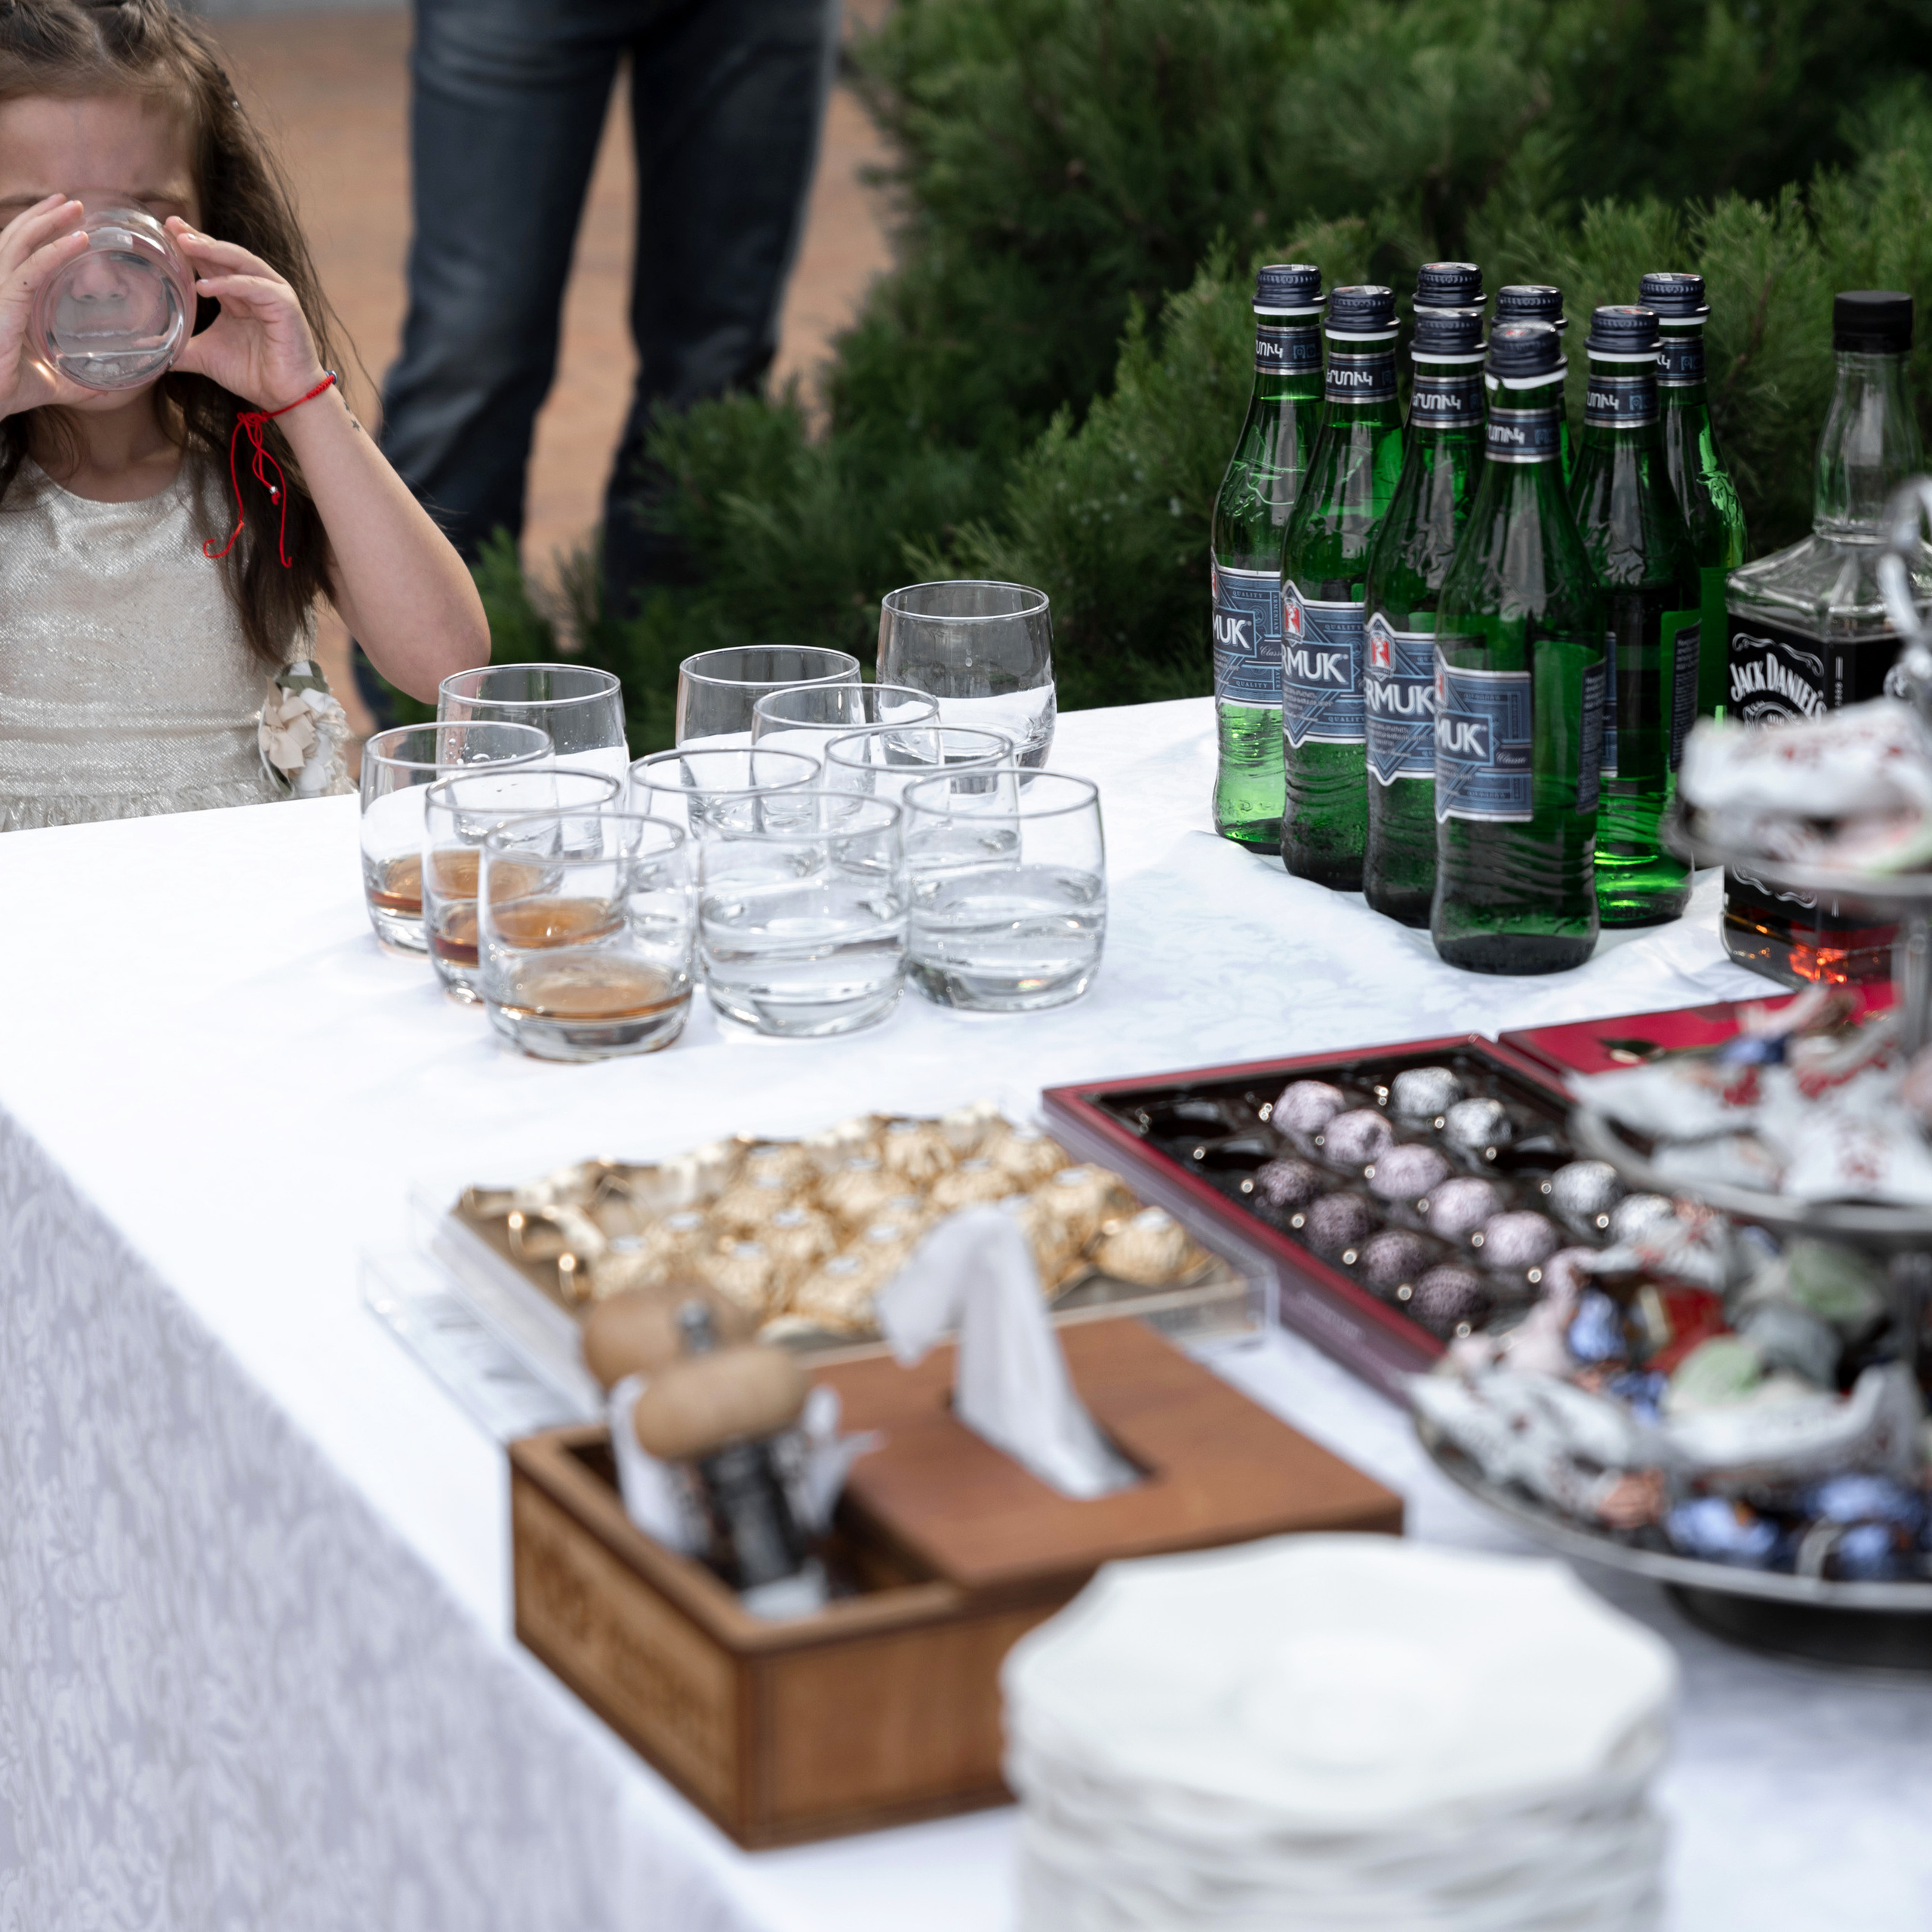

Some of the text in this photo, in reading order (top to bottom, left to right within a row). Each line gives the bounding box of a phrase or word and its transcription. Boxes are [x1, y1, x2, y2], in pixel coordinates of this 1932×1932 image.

[1232, 590, 1263, 598] QUALITY
[1260, 645, 1282, 657] Class
[1236, 680, 1268, 688] QUALITY
[1730, 660, 1767, 703] JACK
